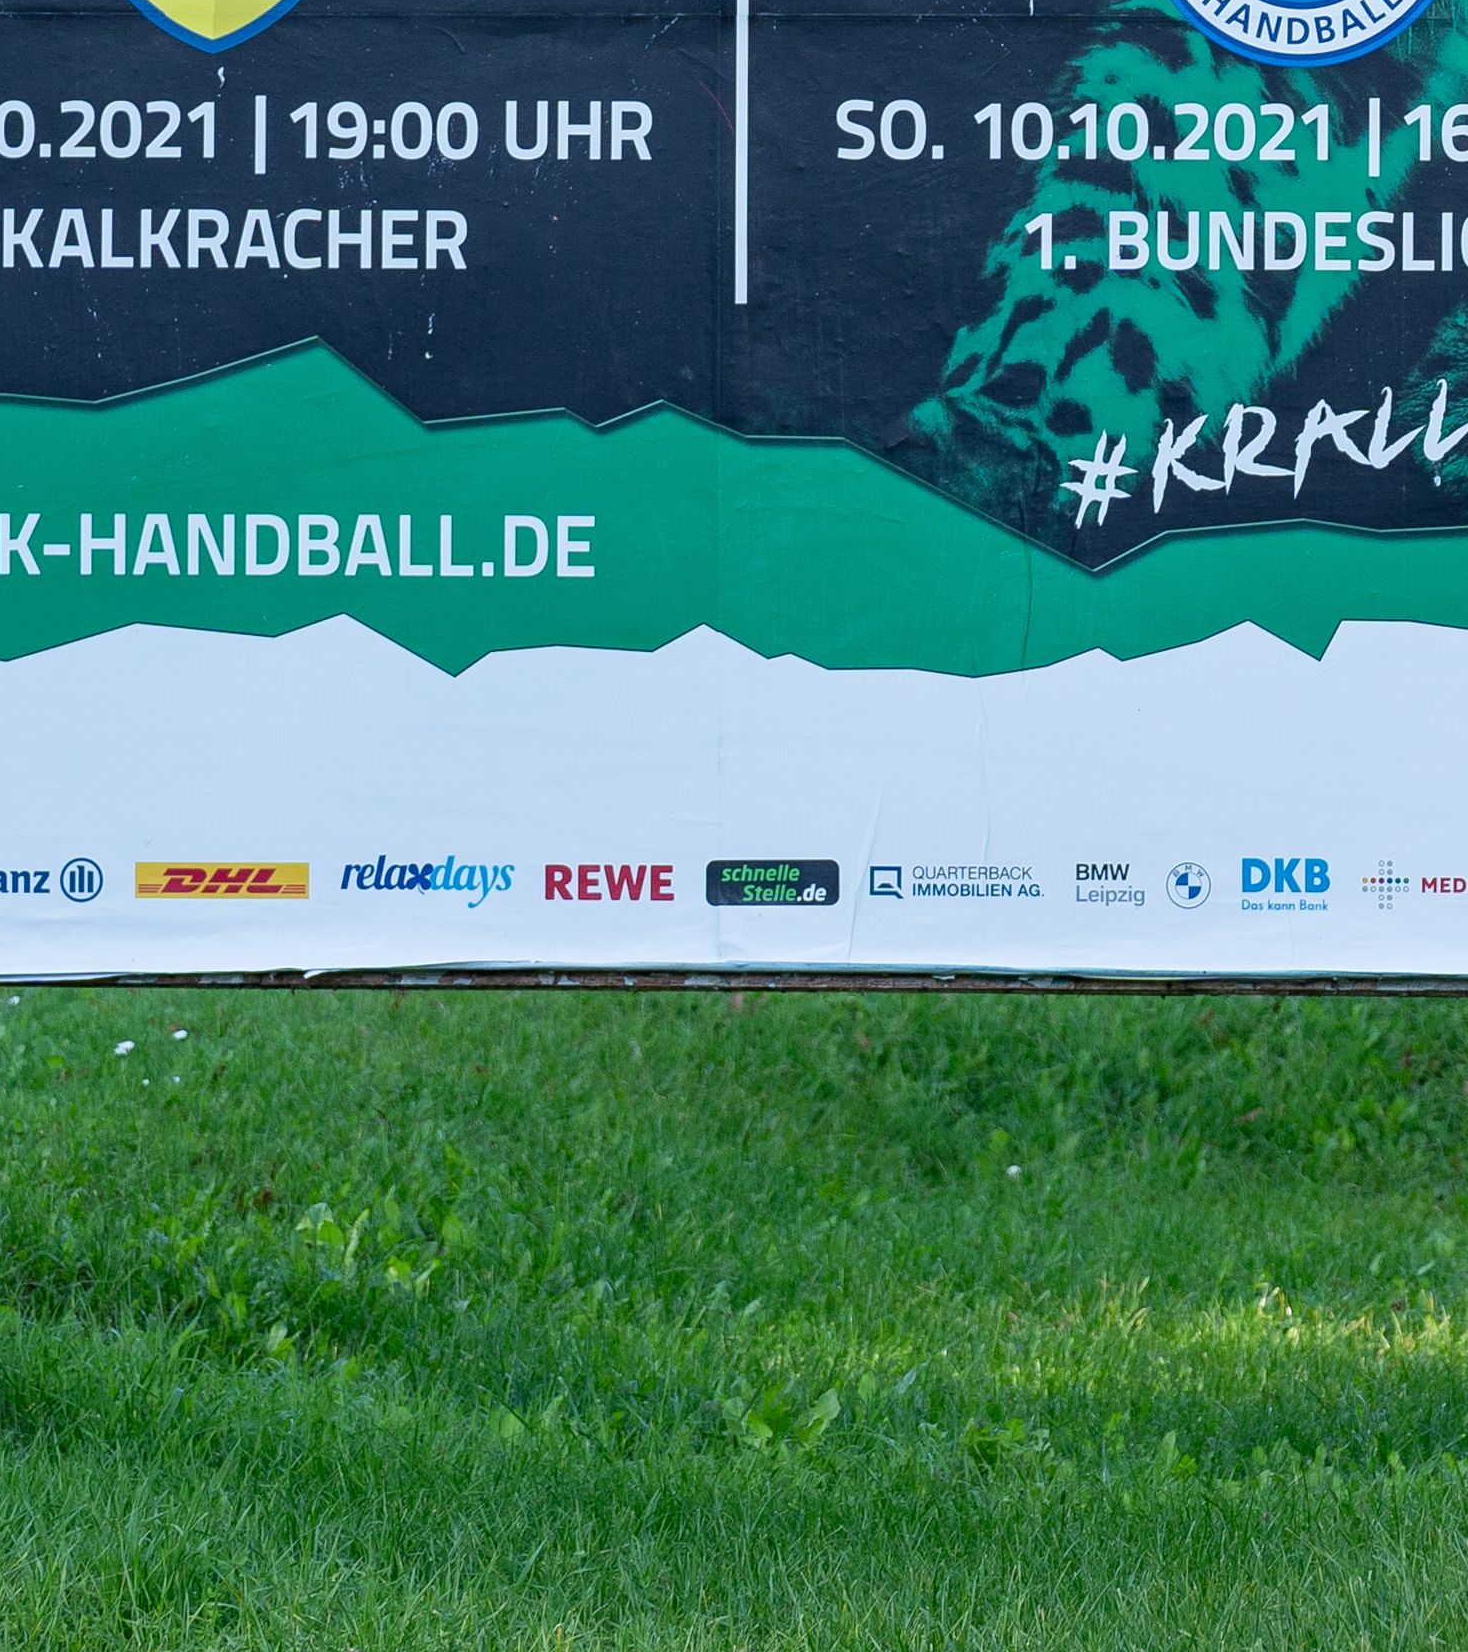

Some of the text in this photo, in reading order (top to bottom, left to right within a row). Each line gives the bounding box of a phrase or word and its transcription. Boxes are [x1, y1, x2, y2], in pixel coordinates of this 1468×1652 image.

[290, 101, 478, 160] 19:00
[505, 100, 652, 160] UHR
[836, 99, 944, 160] SO.
[975, 103, 1328, 160] 10.10.2021
[1026, 214, 1075, 269] 1.
[159, 866, 284, 896] DHL
[341, 855, 515, 908] relaxdays
[545, 864, 674, 901] REWE
[722, 866, 799, 883] schnelle
[912, 866, 1032, 880] QUARTERBACK
[1076, 864, 1129, 880] BMW
[1242, 858, 1330, 893] DKB
[743, 883, 827, 901] Stelle.de
[913, 883, 1045, 897] IMMOBILIEN AG.
[1076, 885, 1145, 907] Leipzig
[1241, 899, 1329, 911] Das kann Bank
